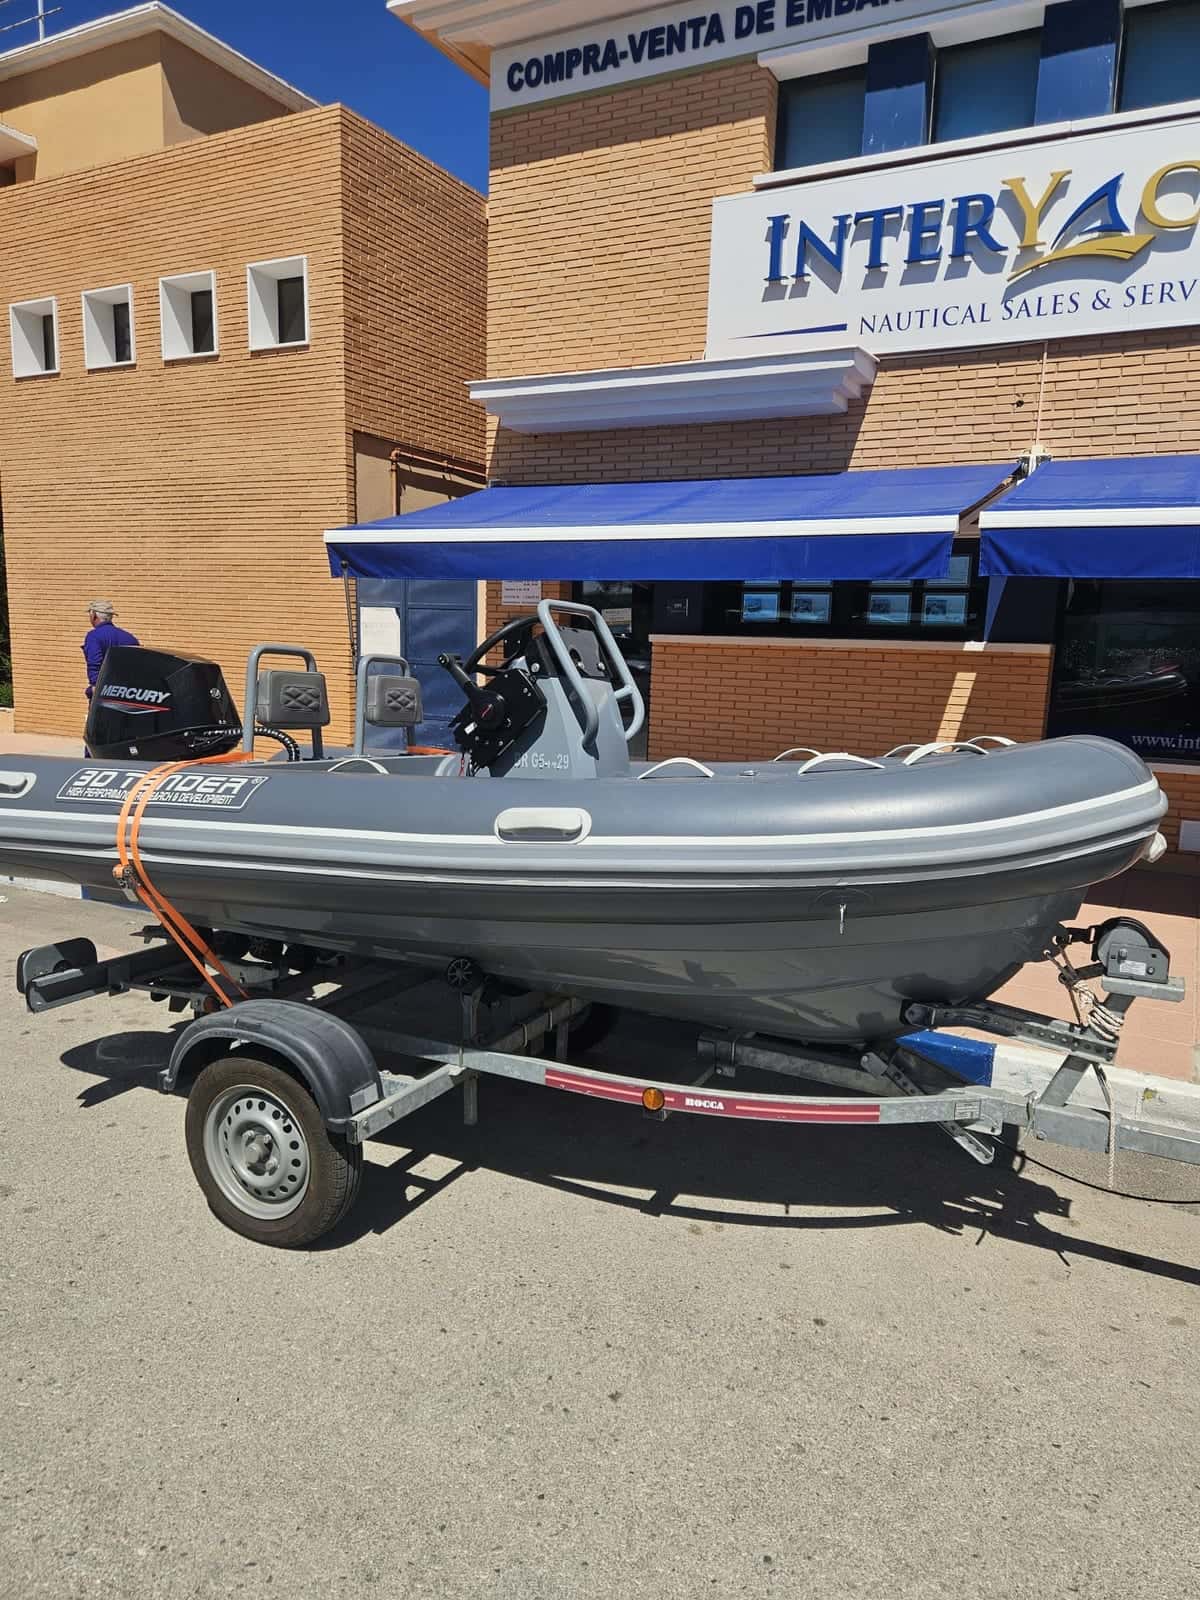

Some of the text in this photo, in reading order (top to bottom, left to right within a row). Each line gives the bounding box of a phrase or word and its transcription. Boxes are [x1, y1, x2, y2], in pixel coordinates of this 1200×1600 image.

[506, 12, 725, 92] COMPRA-VENTA
[734, 0, 775, 40] DE
[859, 302, 991, 335] NAUTICAL
[1000, 291, 1080, 321] SALES
[1091, 288, 1112, 311] &
[101, 684, 171, 703] MERCURY
[83, 787, 131, 802] PERFORMAN
[134, 789, 174, 802] REEARCH
